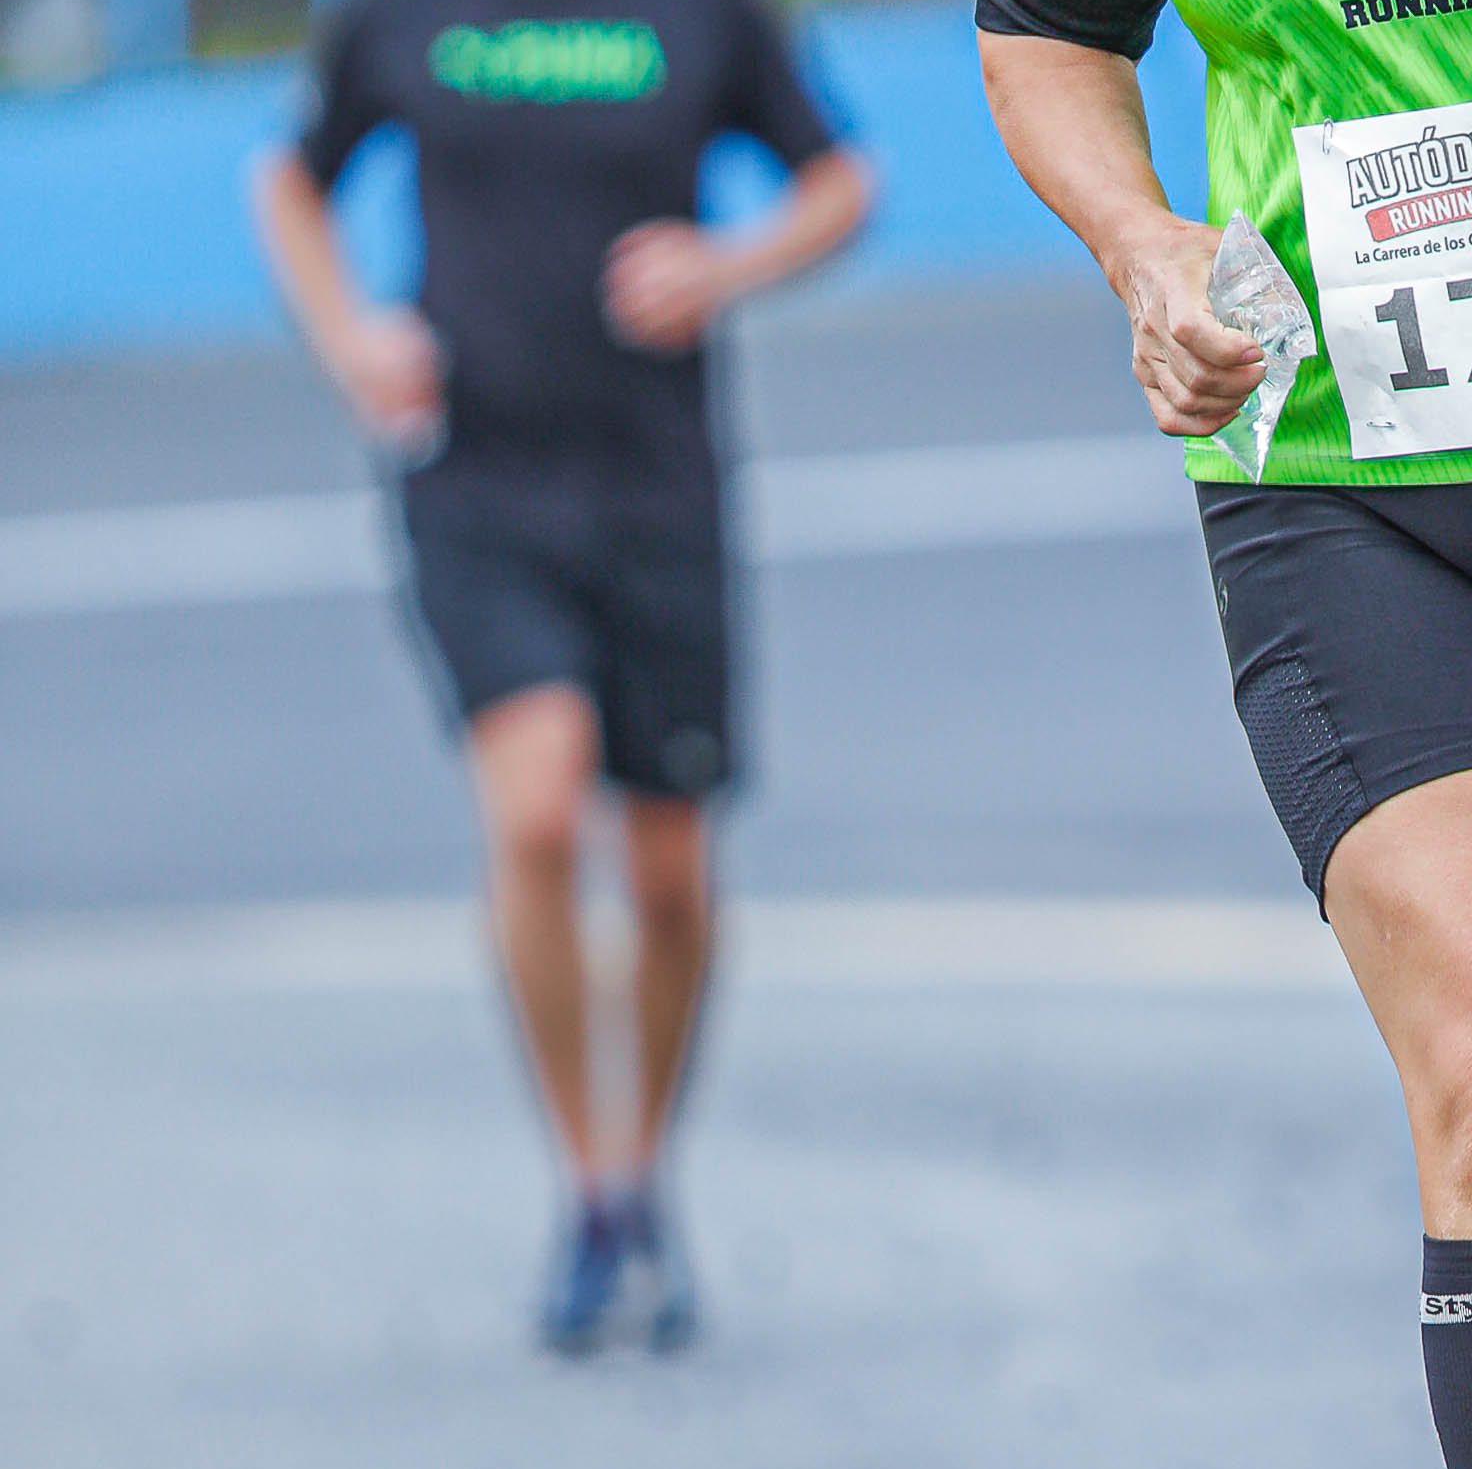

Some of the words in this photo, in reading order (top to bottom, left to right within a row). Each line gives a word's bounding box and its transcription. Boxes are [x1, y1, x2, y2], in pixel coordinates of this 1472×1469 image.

[1355, 250, 1370, 264] La
[1373, 245, 1421, 263] Carrera
[1424, 239, 1441, 254] de
[1445, 235, 1466, 251] los
